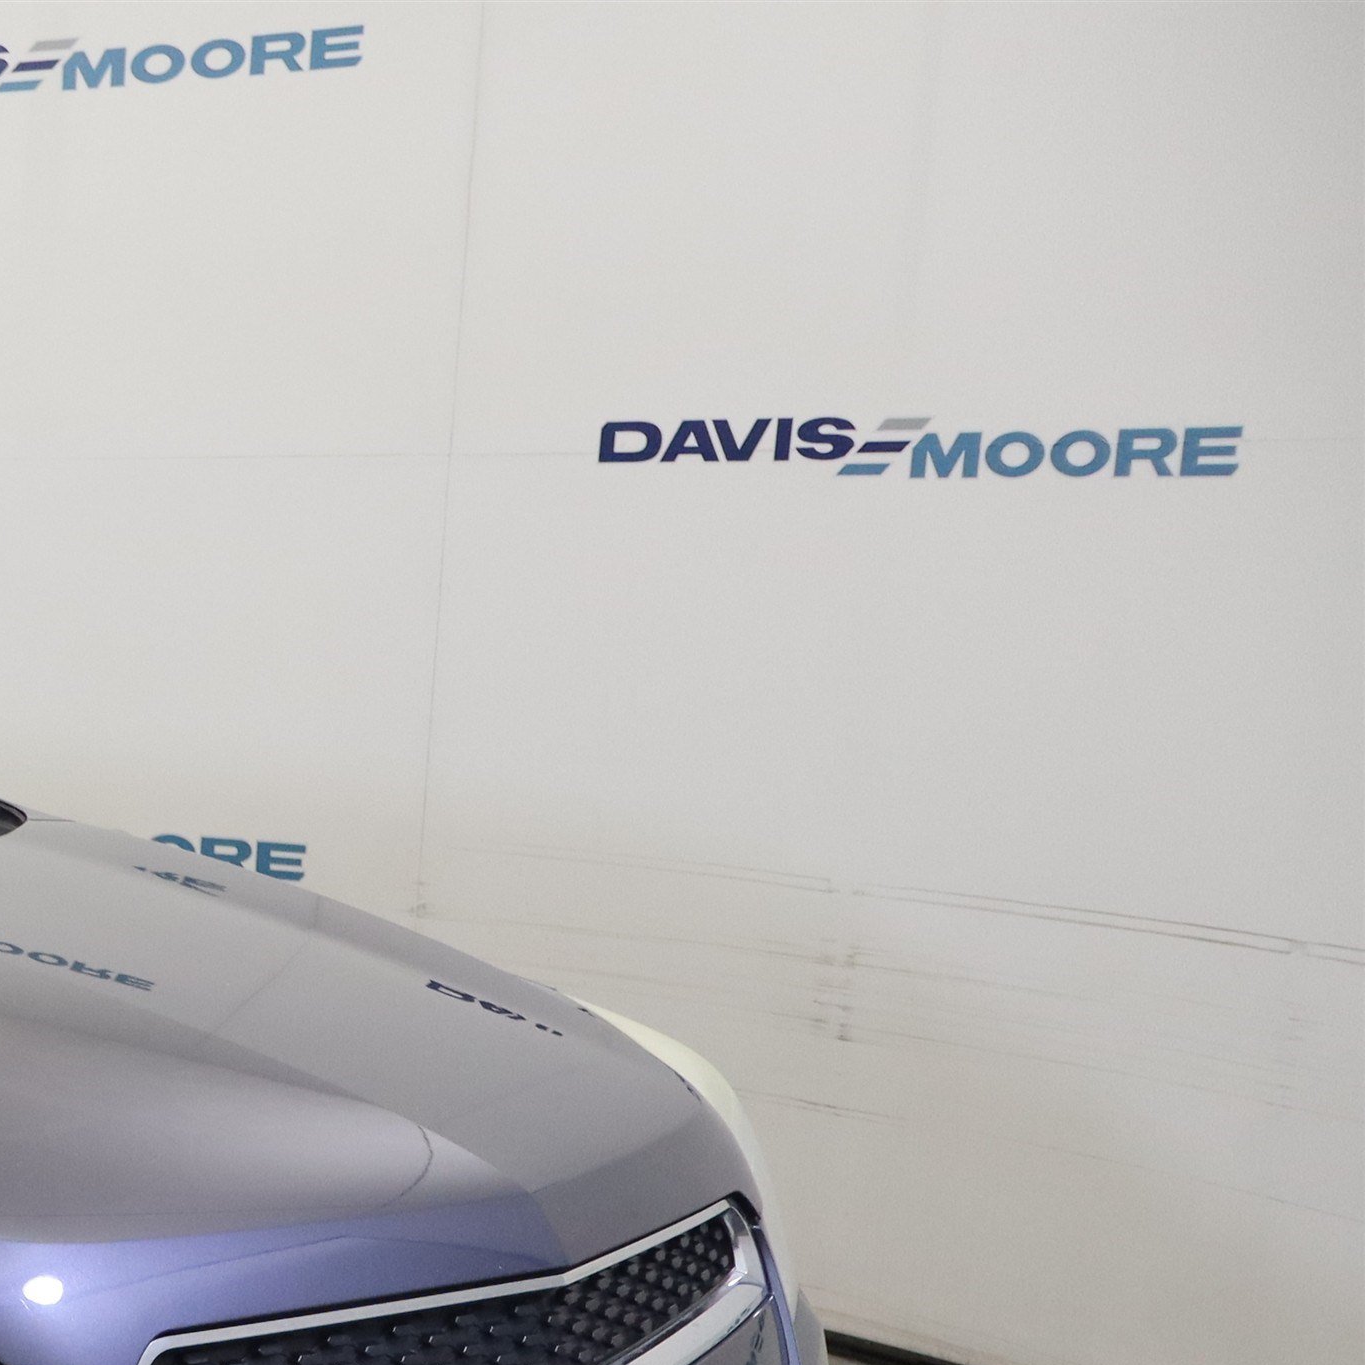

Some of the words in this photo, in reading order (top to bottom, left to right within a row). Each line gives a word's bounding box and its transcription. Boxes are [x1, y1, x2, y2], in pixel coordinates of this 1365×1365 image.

[61, 24, 365, 91] MOORE
[597, 416, 857, 464] DAVIS
[909, 425, 1244, 479] MOORE
